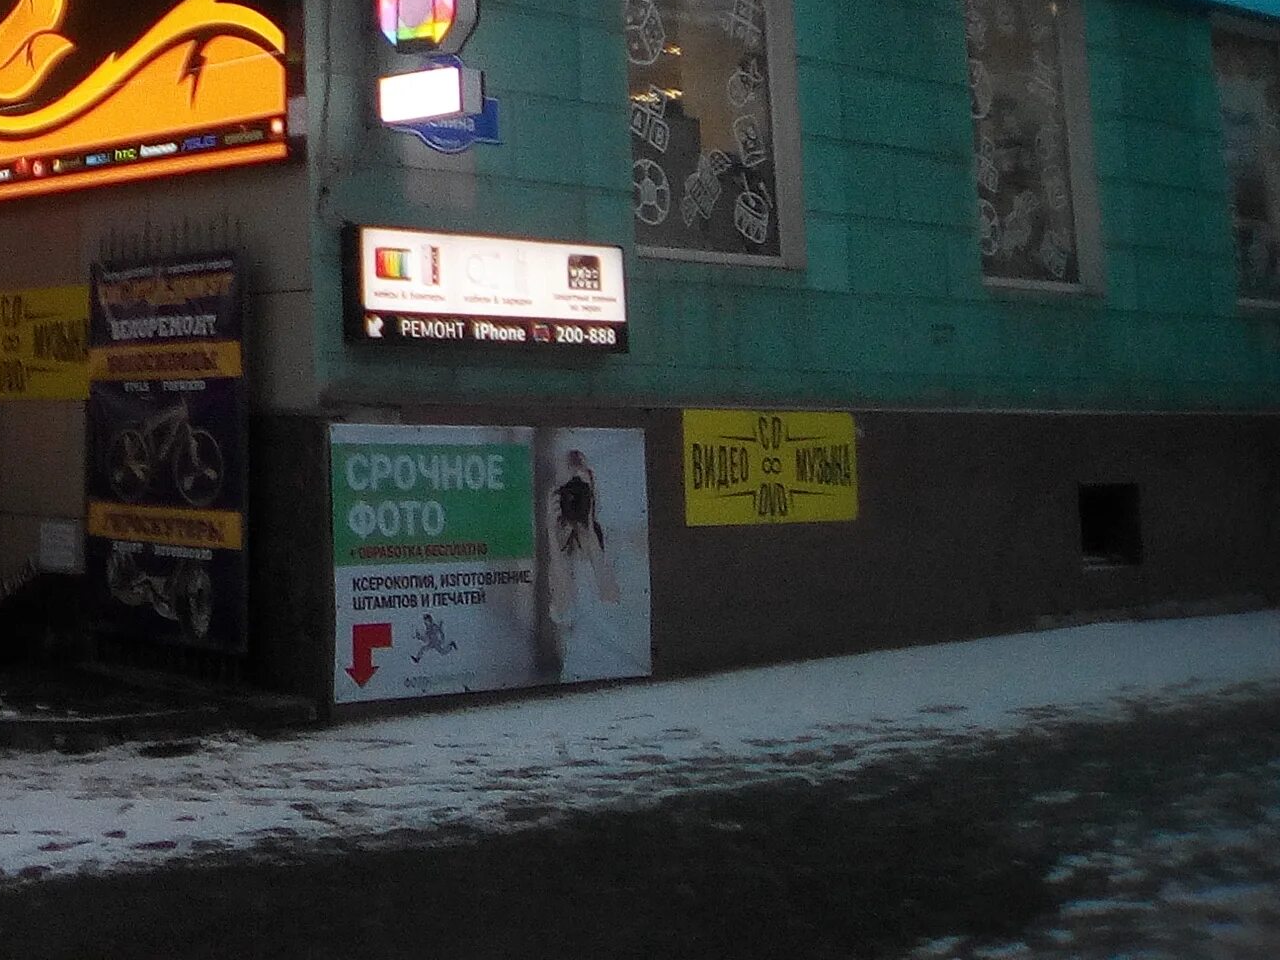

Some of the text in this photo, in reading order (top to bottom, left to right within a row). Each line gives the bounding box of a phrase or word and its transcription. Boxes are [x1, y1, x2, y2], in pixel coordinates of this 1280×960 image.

[401, 318, 617, 345] РЕМОНТ iPhone 200-888
[346, 452, 505, 492] СРОЧНОЕ
[692, 443, 749, 489] ВИДЕО
[348, 500, 446, 540] ФОТО
[352, 570, 532, 591] КСЕРОКОПИЯ, ИЗГОТОВЛЕНИЕ
[353, 588, 486, 611] ШТАМПОВ И ПЕЧАТЕЙ
